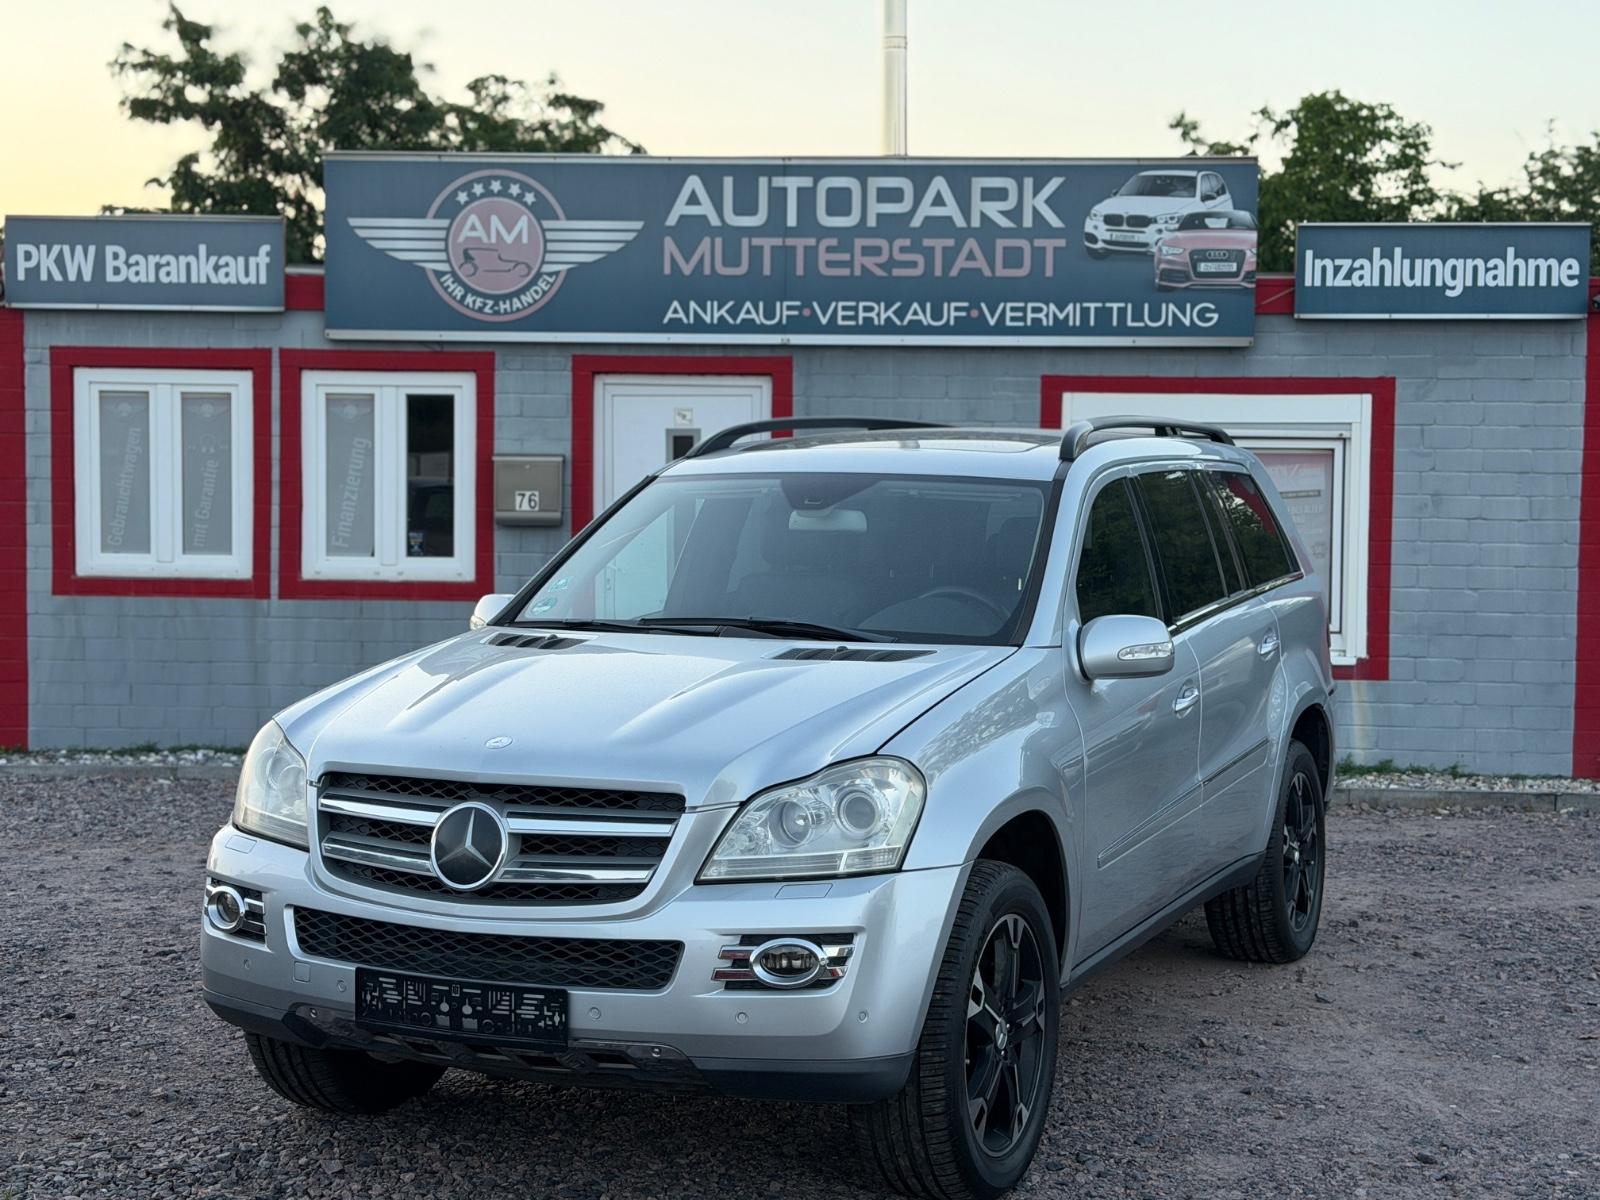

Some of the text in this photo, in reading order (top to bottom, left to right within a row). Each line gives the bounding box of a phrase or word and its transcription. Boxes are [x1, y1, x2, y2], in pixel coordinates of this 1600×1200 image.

[664, 174, 1066, 228] AUTOPARK
[456, 214, 529, 245] AM
[16, 243, 271, 285] PKW Barankauf
[663, 236, 1066, 277] MUTTERSTADT
[1304, 246, 1580, 298] Inzahlungnahme
[440, 273, 556, 314] IHR KFZ-HANDEL
[662, 300, 1219, 327] ANKAUF VERKAUF VERMITTLUNG
[107, 427, 143, 546] Gebrauchtwagen
[190, 459, 219, 547] mit Garantie
[332, 437, 372, 547] Finanzierung
[517, 492, 538, 509] 76
